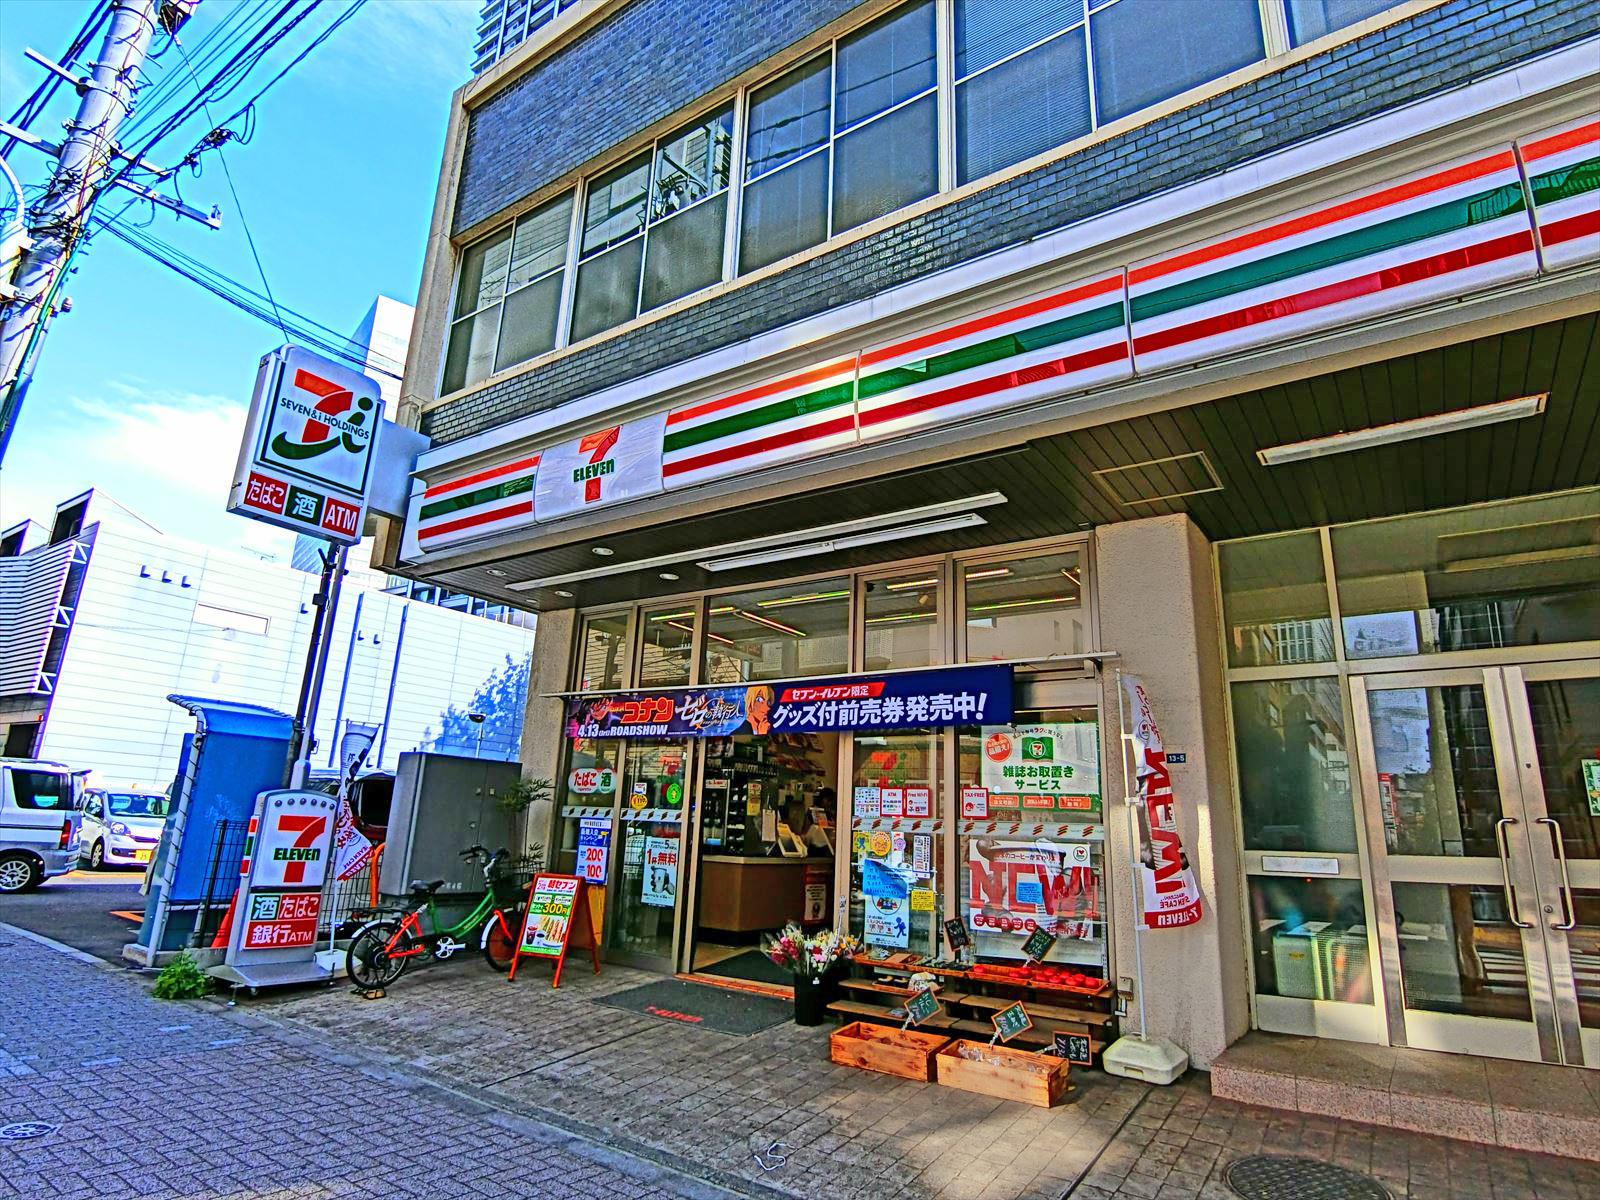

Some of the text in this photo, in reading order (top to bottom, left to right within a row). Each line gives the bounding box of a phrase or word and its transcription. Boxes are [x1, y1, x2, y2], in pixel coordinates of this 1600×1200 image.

[324, 415, 370, 440] HOLDINGS
[246, 479, 285, 509] たばこ
[293, 492, 318, 519] 酒
[325, 504, 358, 532] ATM
[578, 723, 599, 737] 4.13
[610, 725, 668, 736] ROADSHOW
[1168, 754, 1185, 762] 13-5
[574, 771, 597, 786] たばこ
[1002, 765, 1074, 778] 雑誌お取置き
[600, 772, 612, 787] 酒
[1014, 779, 1061, 790] サービス
[252, 896, 319, 920] 酒 たばこ
